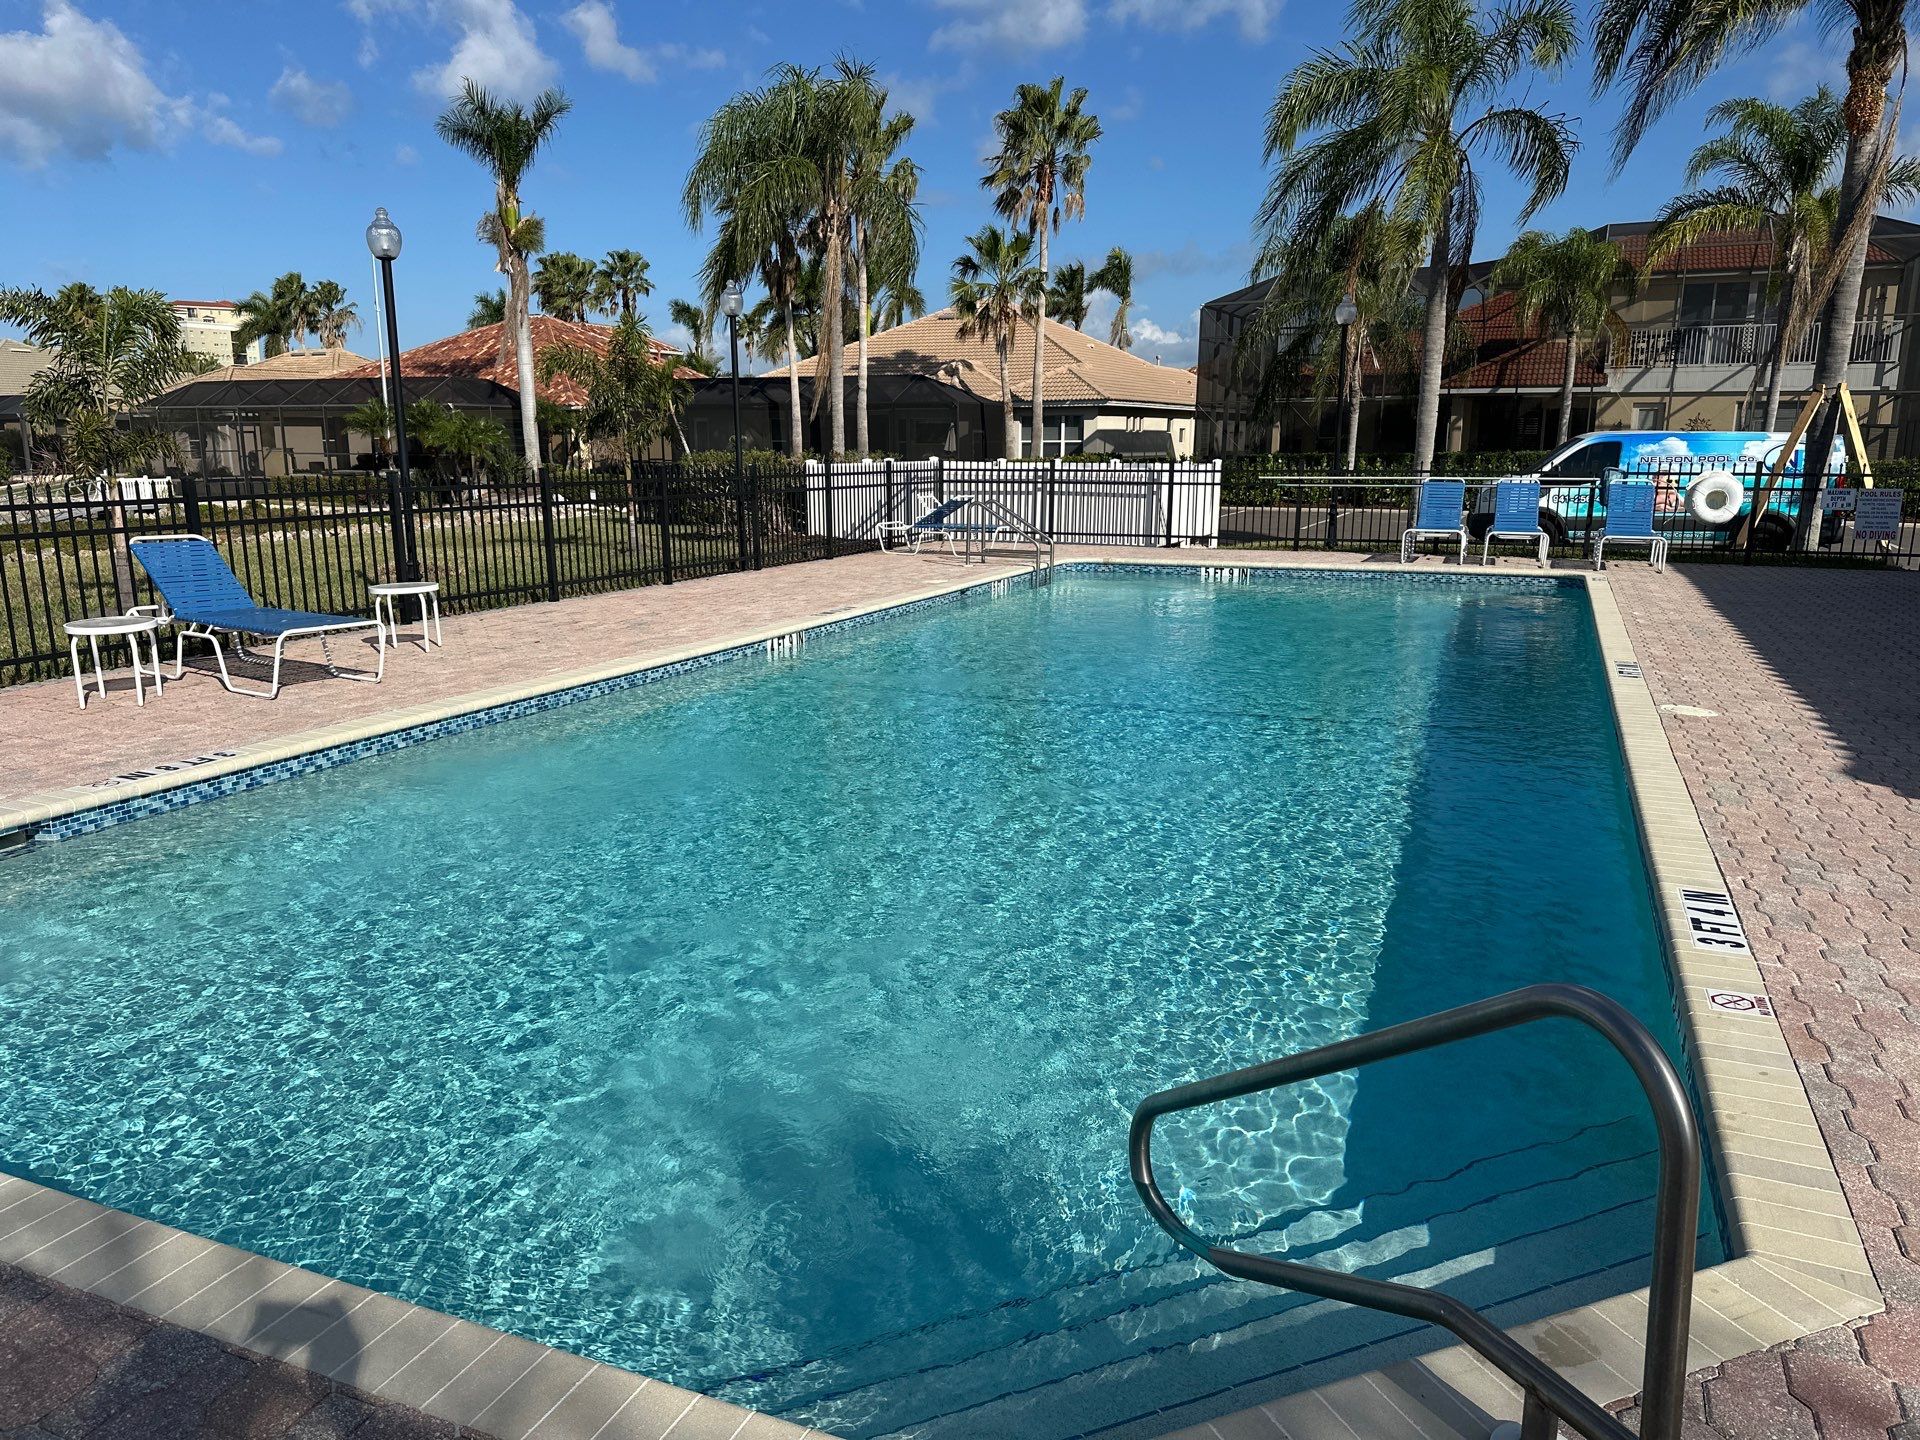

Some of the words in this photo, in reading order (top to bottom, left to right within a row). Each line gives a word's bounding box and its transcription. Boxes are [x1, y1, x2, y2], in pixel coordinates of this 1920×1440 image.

[1855, 531, 1867, 539] NO
[1869, 531, 1896, 540] DIVING
[1213, 567, 1224, 582] FT
[1238, 568, 1249, 583] IN
[180, 757, 218, 766] FT
[116, 771, 157, 780] IN
[1682, 889, 1730, 906] IN
[1686, 906, 1734, 917] 4
[1690, 917, 1741, 937] FT
[1696, 937, 1746, 949] 3
